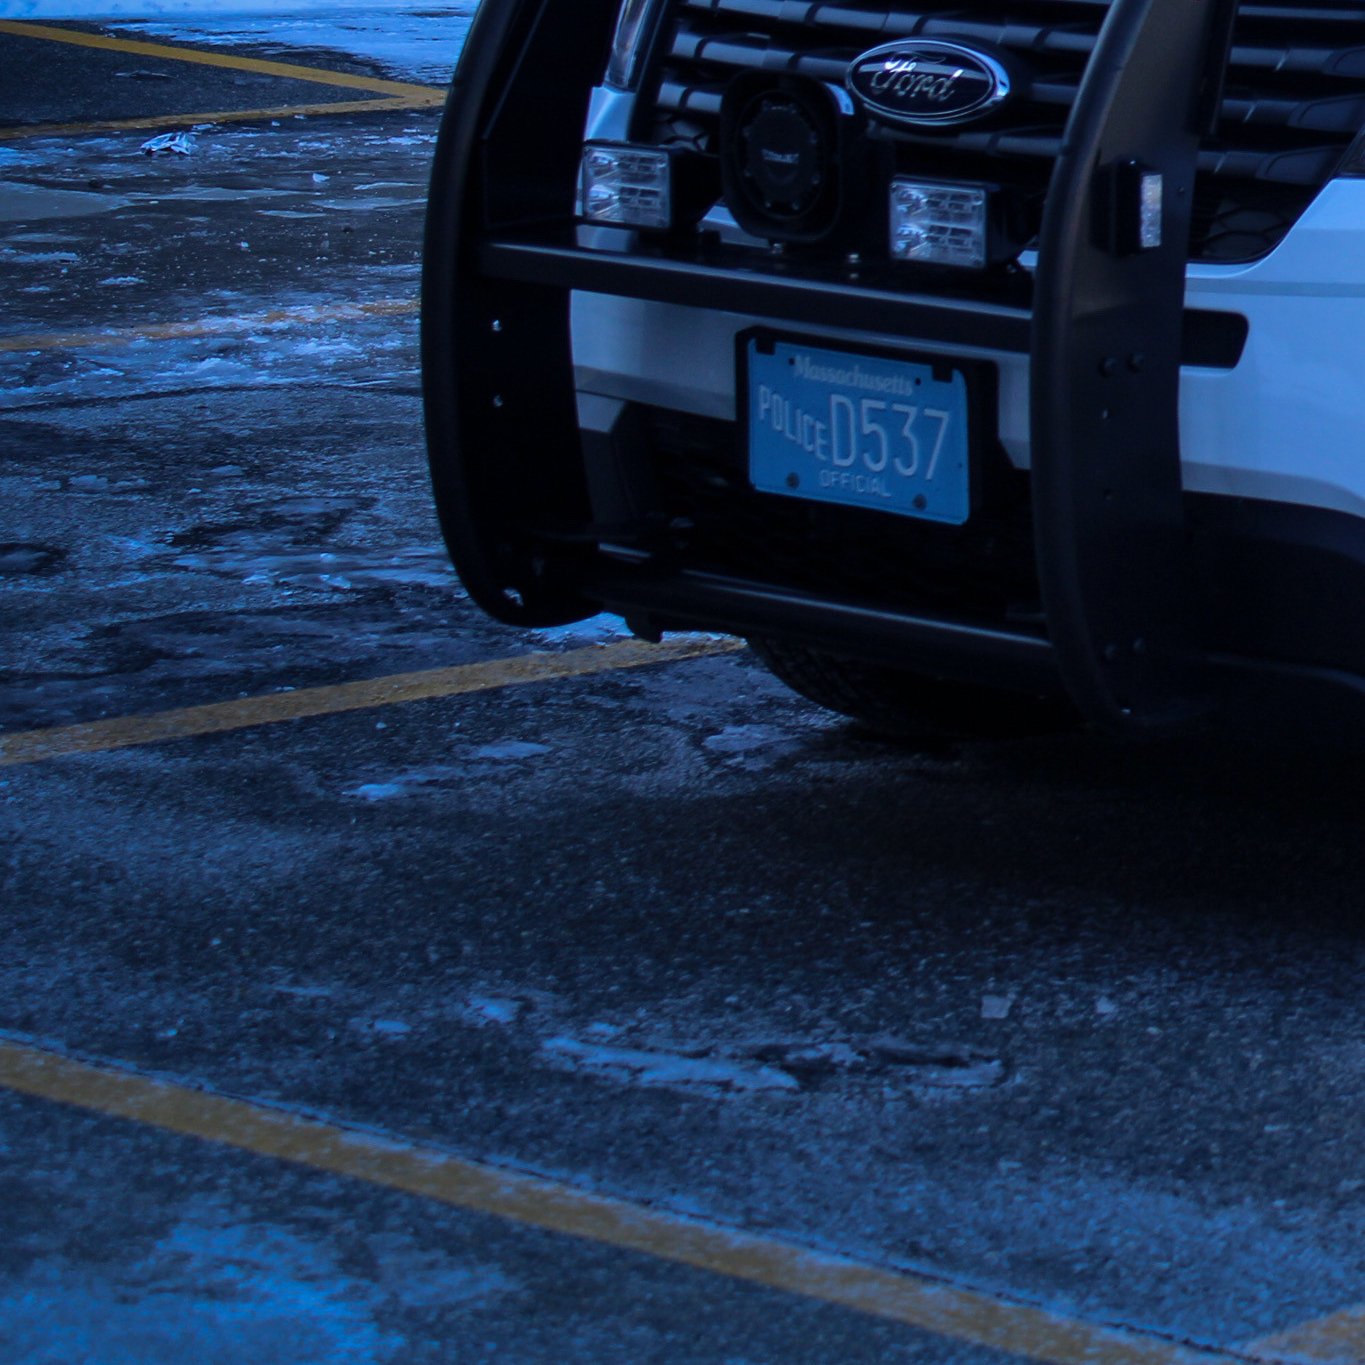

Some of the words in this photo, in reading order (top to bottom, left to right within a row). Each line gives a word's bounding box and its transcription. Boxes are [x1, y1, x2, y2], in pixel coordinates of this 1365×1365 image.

[870, 50, 962, 102] Ford
[794, 355, 913, 396] Massachusetts
[758, 385, 828, 461] POLICE
[830, 393, 950, 481] D537
[819, 469, 892, 498] OFFICIAL
